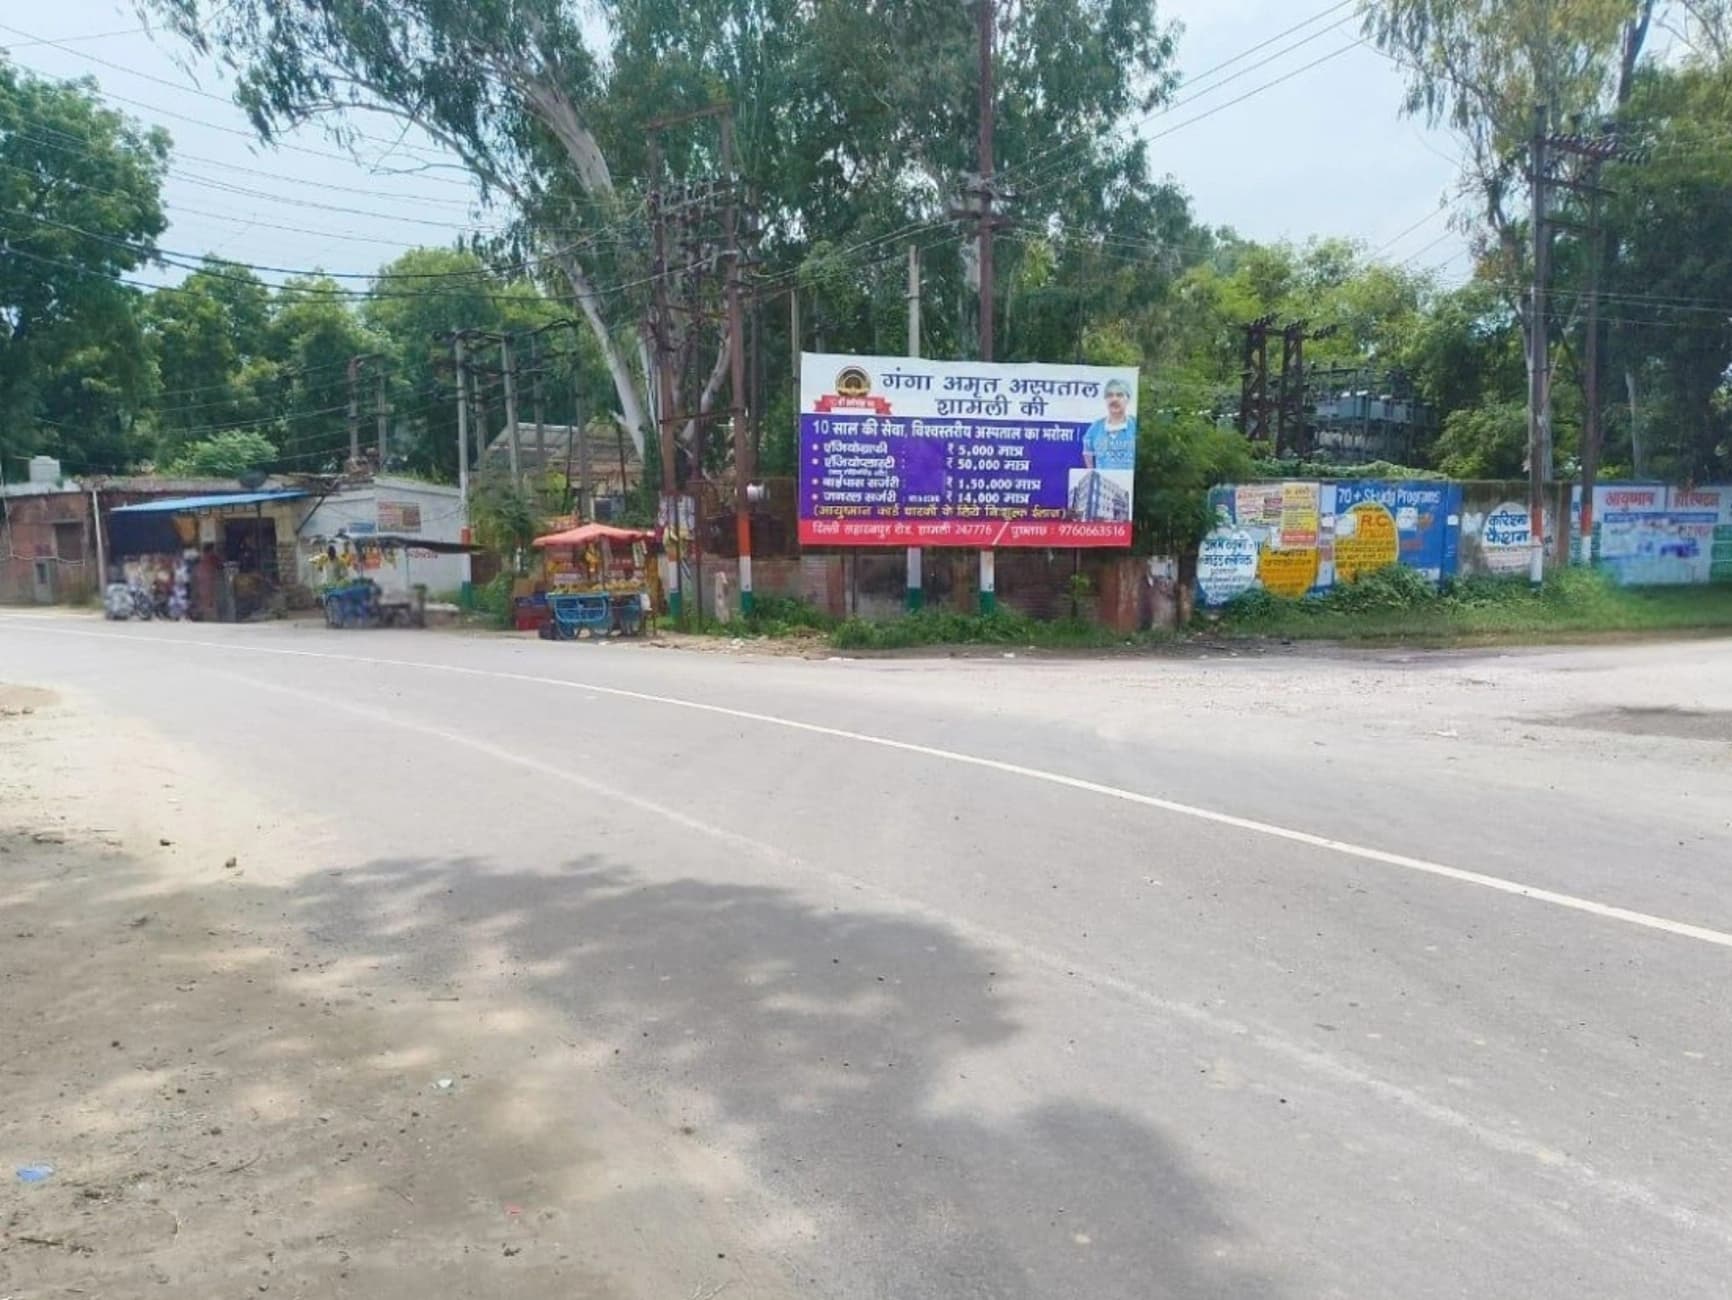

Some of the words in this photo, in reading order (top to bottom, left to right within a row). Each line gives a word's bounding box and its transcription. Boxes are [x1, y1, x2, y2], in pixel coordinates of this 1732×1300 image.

[881, 367, 935, 390] गंगा
[943, 376, 1001, 398] अमृत
[1009, 379, 1101, 398] अस्पताल
[935, 394, 1012, 416] शामली
[1020, 394, 1049, 416] की
[813, 420, 829, 435] 10
[831, 421, 859, 436] साल
[860, 418, 878, 436] की
[975, 426, 1021, 440] अस्पताल
[1023, 427, 1039, 441] का
[1042, 425, 1074, 441] भरोसा
[997, 445, 1025, 457] मात्र
[1003, 459, 1031, 471] मात्र
[1014, 479, 1042, 490] मात्र
[1003, 493, 1031, 503] मात्र
